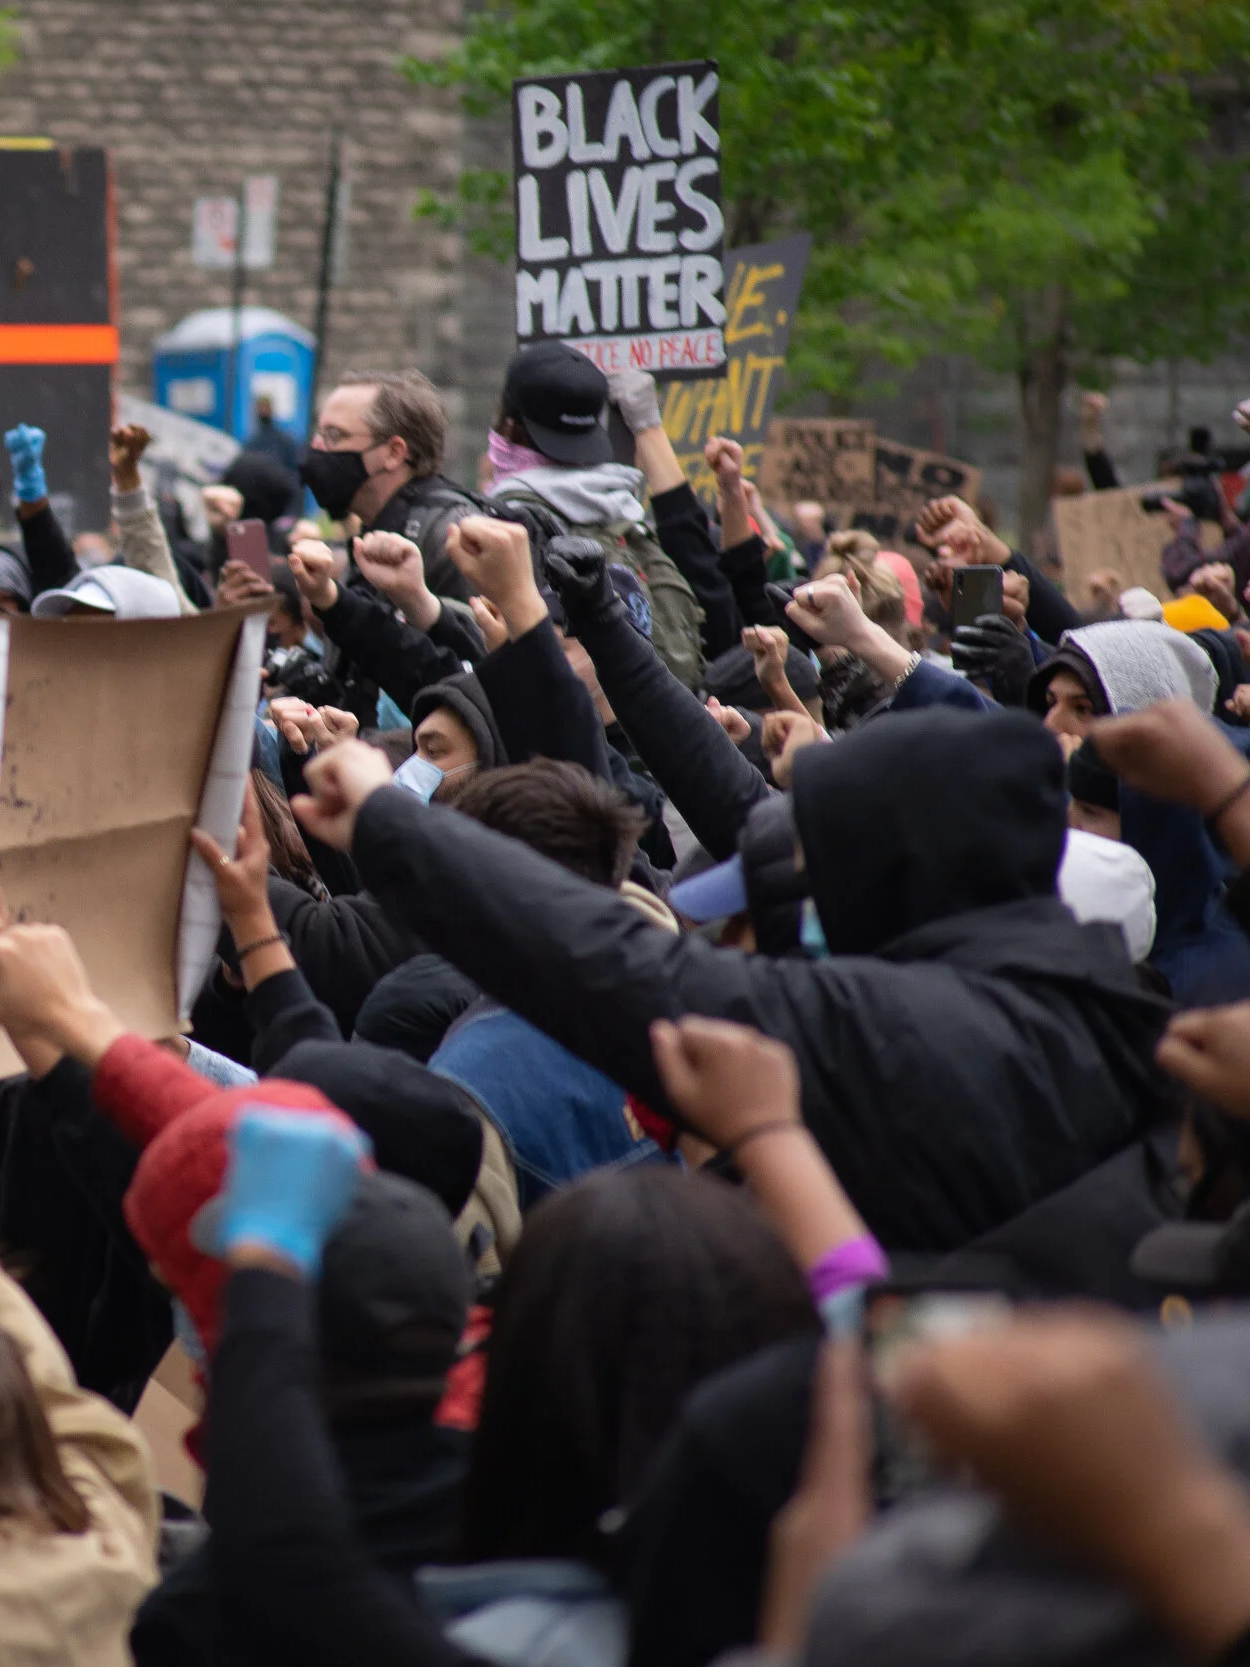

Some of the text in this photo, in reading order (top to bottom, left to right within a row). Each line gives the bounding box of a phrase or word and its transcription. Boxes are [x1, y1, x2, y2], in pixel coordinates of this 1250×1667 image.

[517, 71, 721, 169] BLACK
[517, 156, 725, 262] LIVES
[515, 253, 728, 337] MATTER
[629, 337, 654, 369] NO
[658, 334, 721, 369] PEACE
